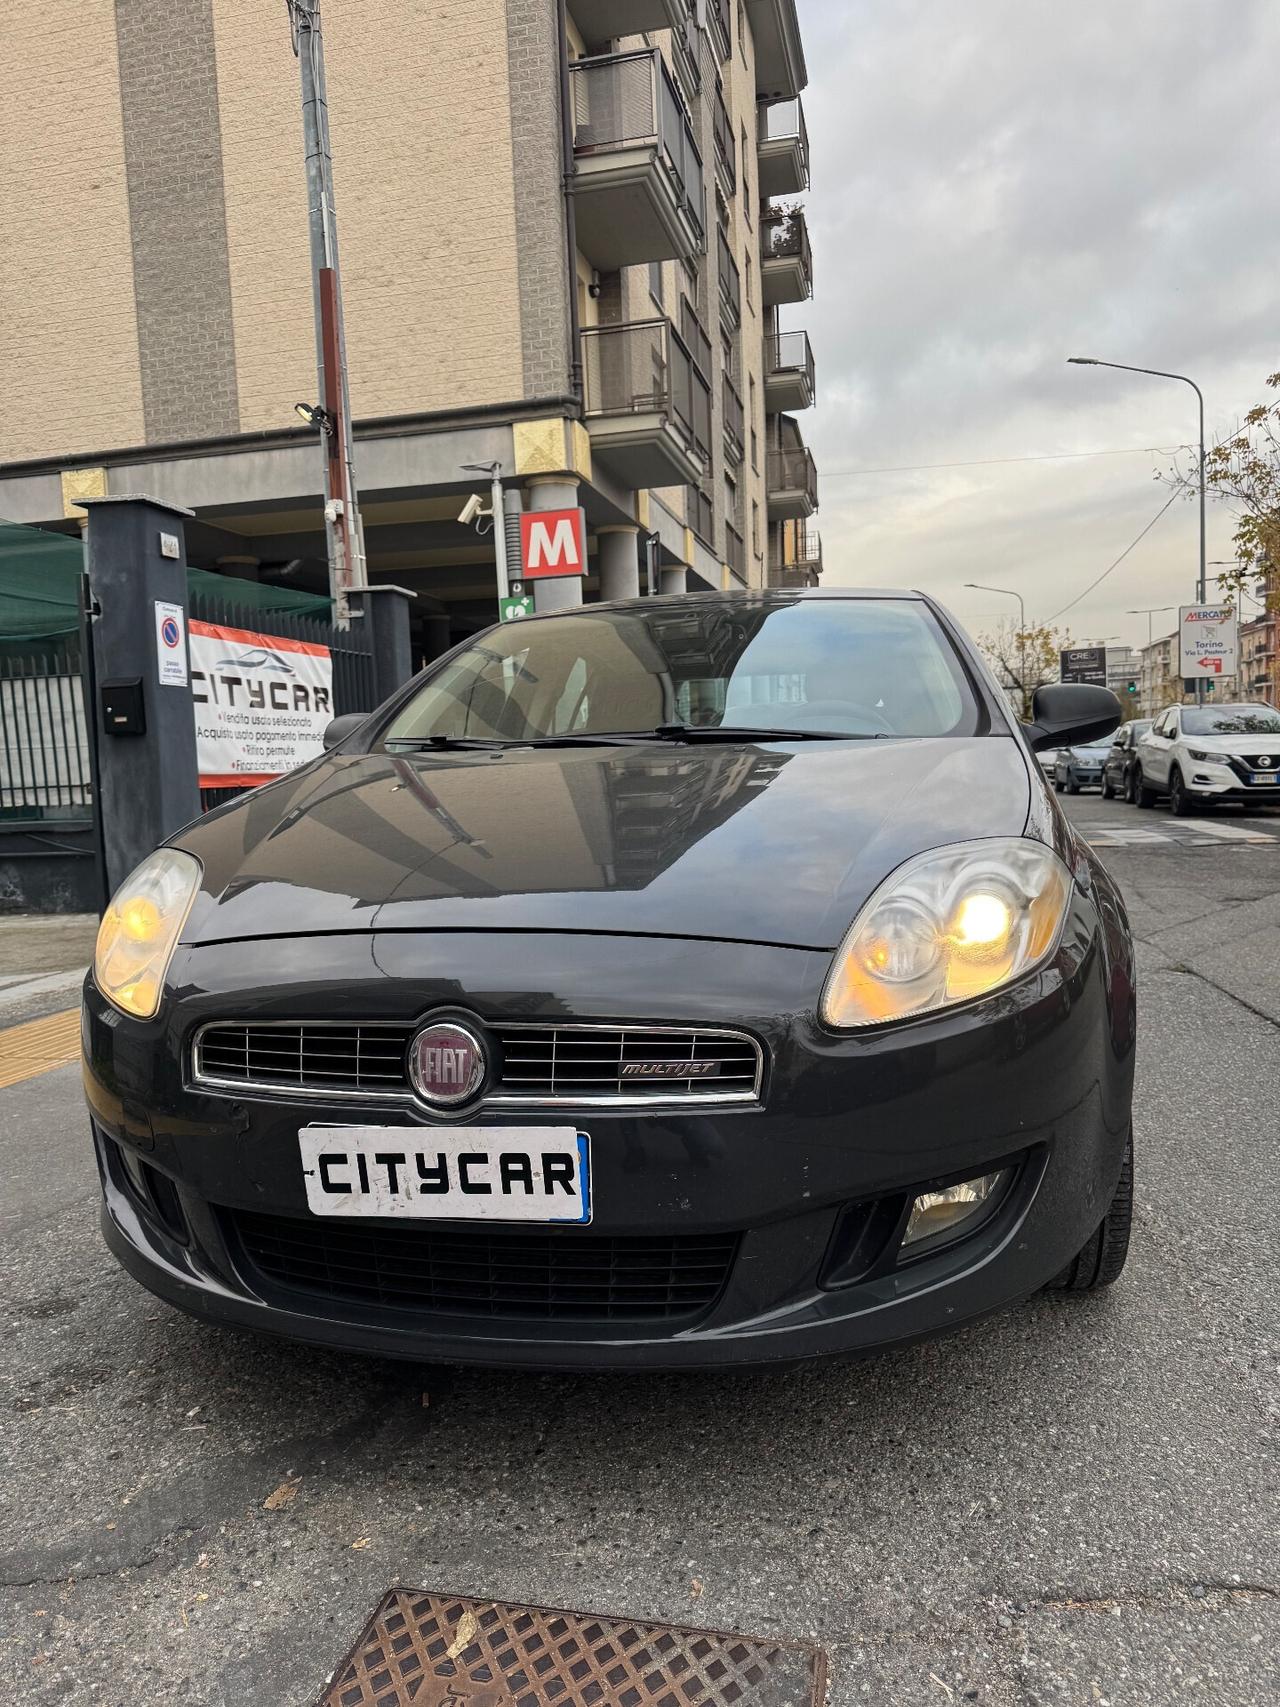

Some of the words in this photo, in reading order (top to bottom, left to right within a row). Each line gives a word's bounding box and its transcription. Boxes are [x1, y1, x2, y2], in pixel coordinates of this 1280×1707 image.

[526, 518, 580, 568] M
[1195, 641, 1223, 649] Torino
[191, 671, 331, 714] CITYCAR
[251, 714, 271, 727] usato
[272, 715, 312, 728] selezionato
[197, 726, 234, 740] Acquisto
[234, 730, 254, 741] usato
[255, 730, 297, 743] pagamento
[246, 744, 265, 756] Ritiro
[266, 745, 295, 758] permute
[425, 1047, 468, 1084] FIAT
[621, 1062, 715, 1077] MULTIJET
[318, 1152, 577, 1196] CITYCAR
